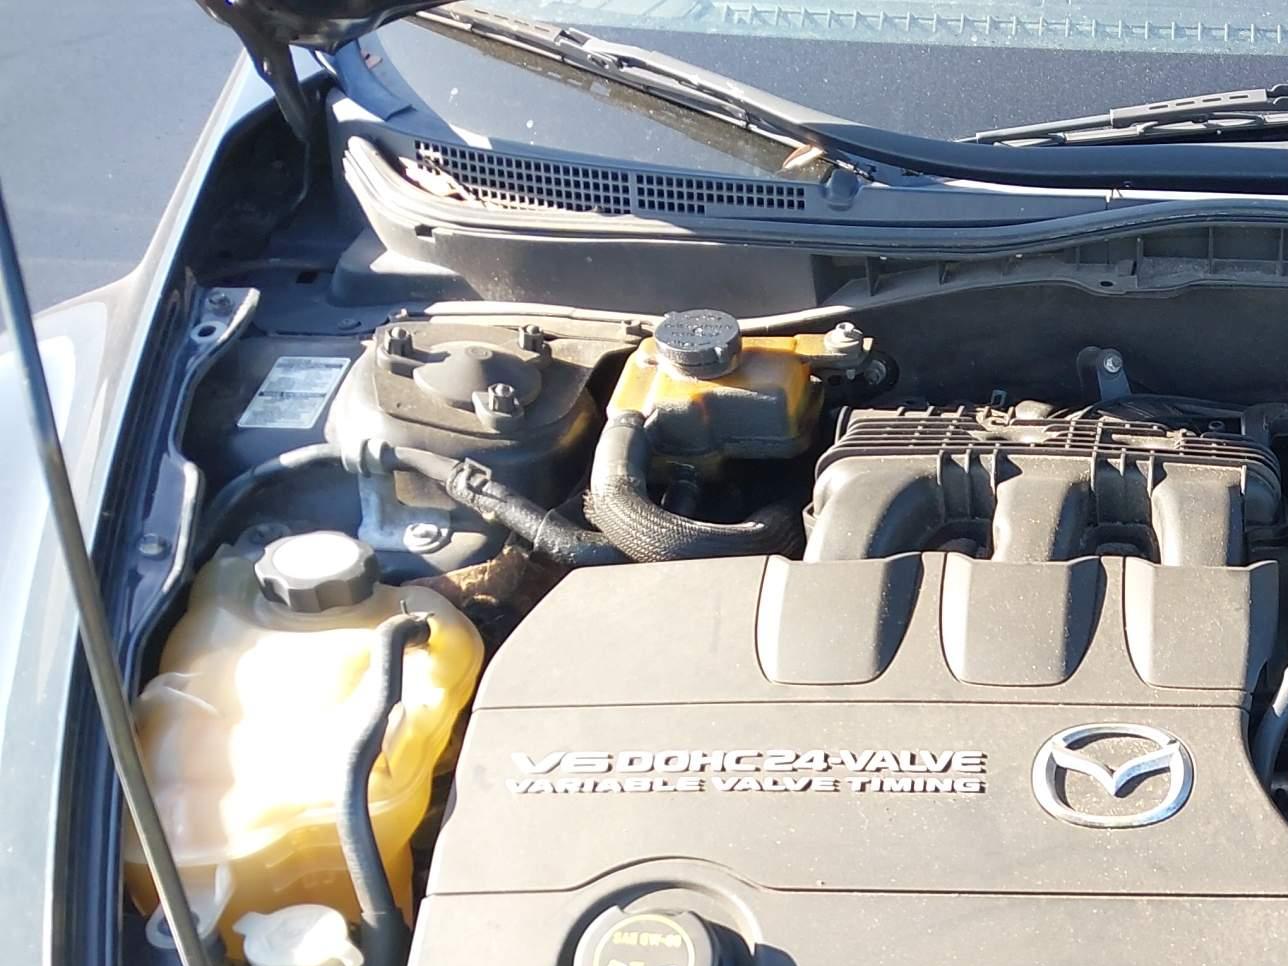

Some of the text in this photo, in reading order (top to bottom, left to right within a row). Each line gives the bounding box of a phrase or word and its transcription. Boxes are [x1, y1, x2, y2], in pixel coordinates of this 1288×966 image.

[510, 749, 988, 774] V6 DOHC 24-VALVE
[504, 775, 987, 794] VARIABLE VALVE TIMING
